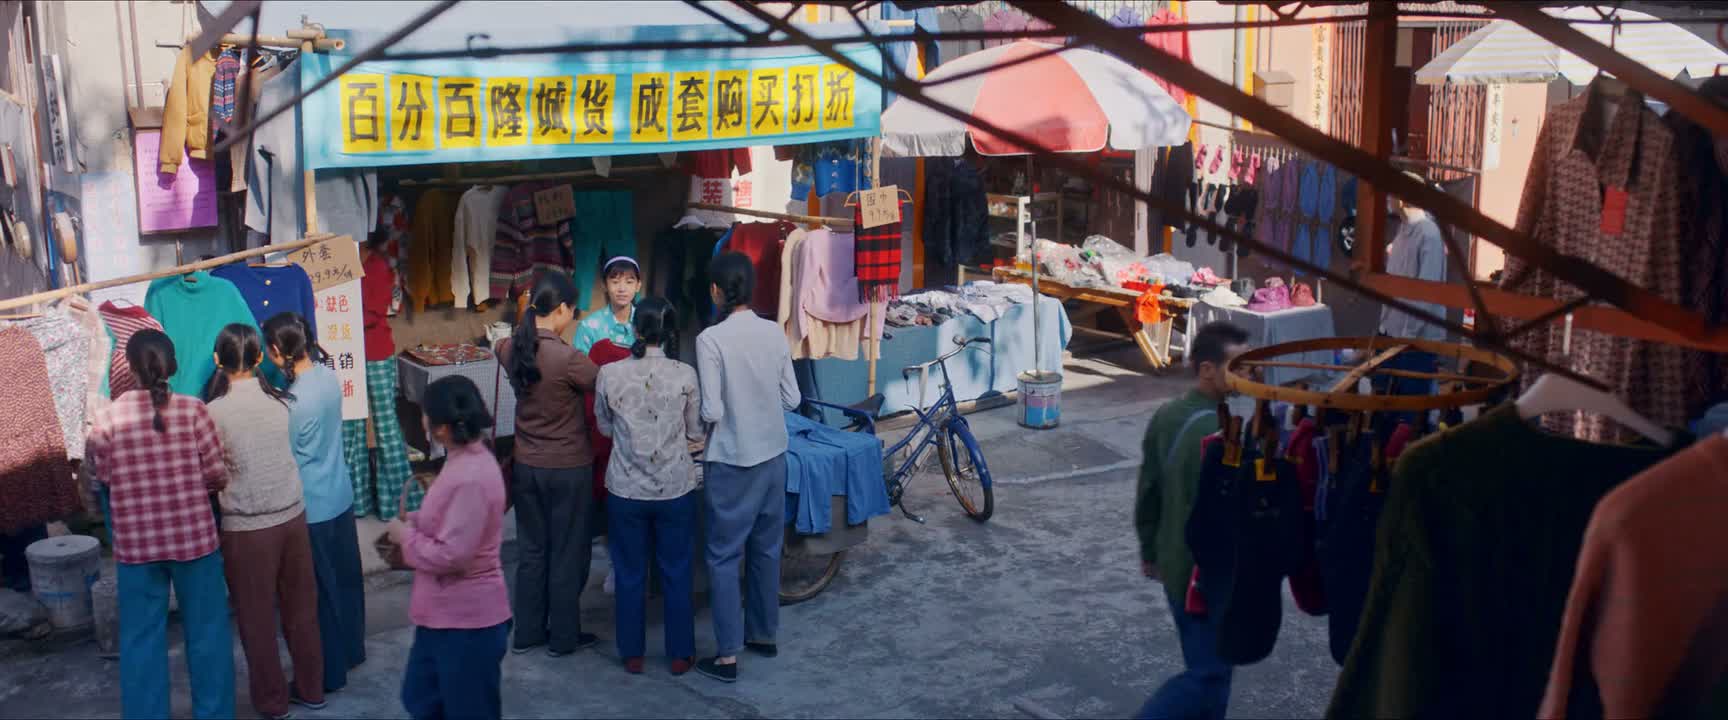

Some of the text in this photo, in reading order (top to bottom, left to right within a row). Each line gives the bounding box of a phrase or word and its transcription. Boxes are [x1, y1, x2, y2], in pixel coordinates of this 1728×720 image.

[636, 71, 851, 134] 成套购买打折
[302, 244, 332, 263] 外套
